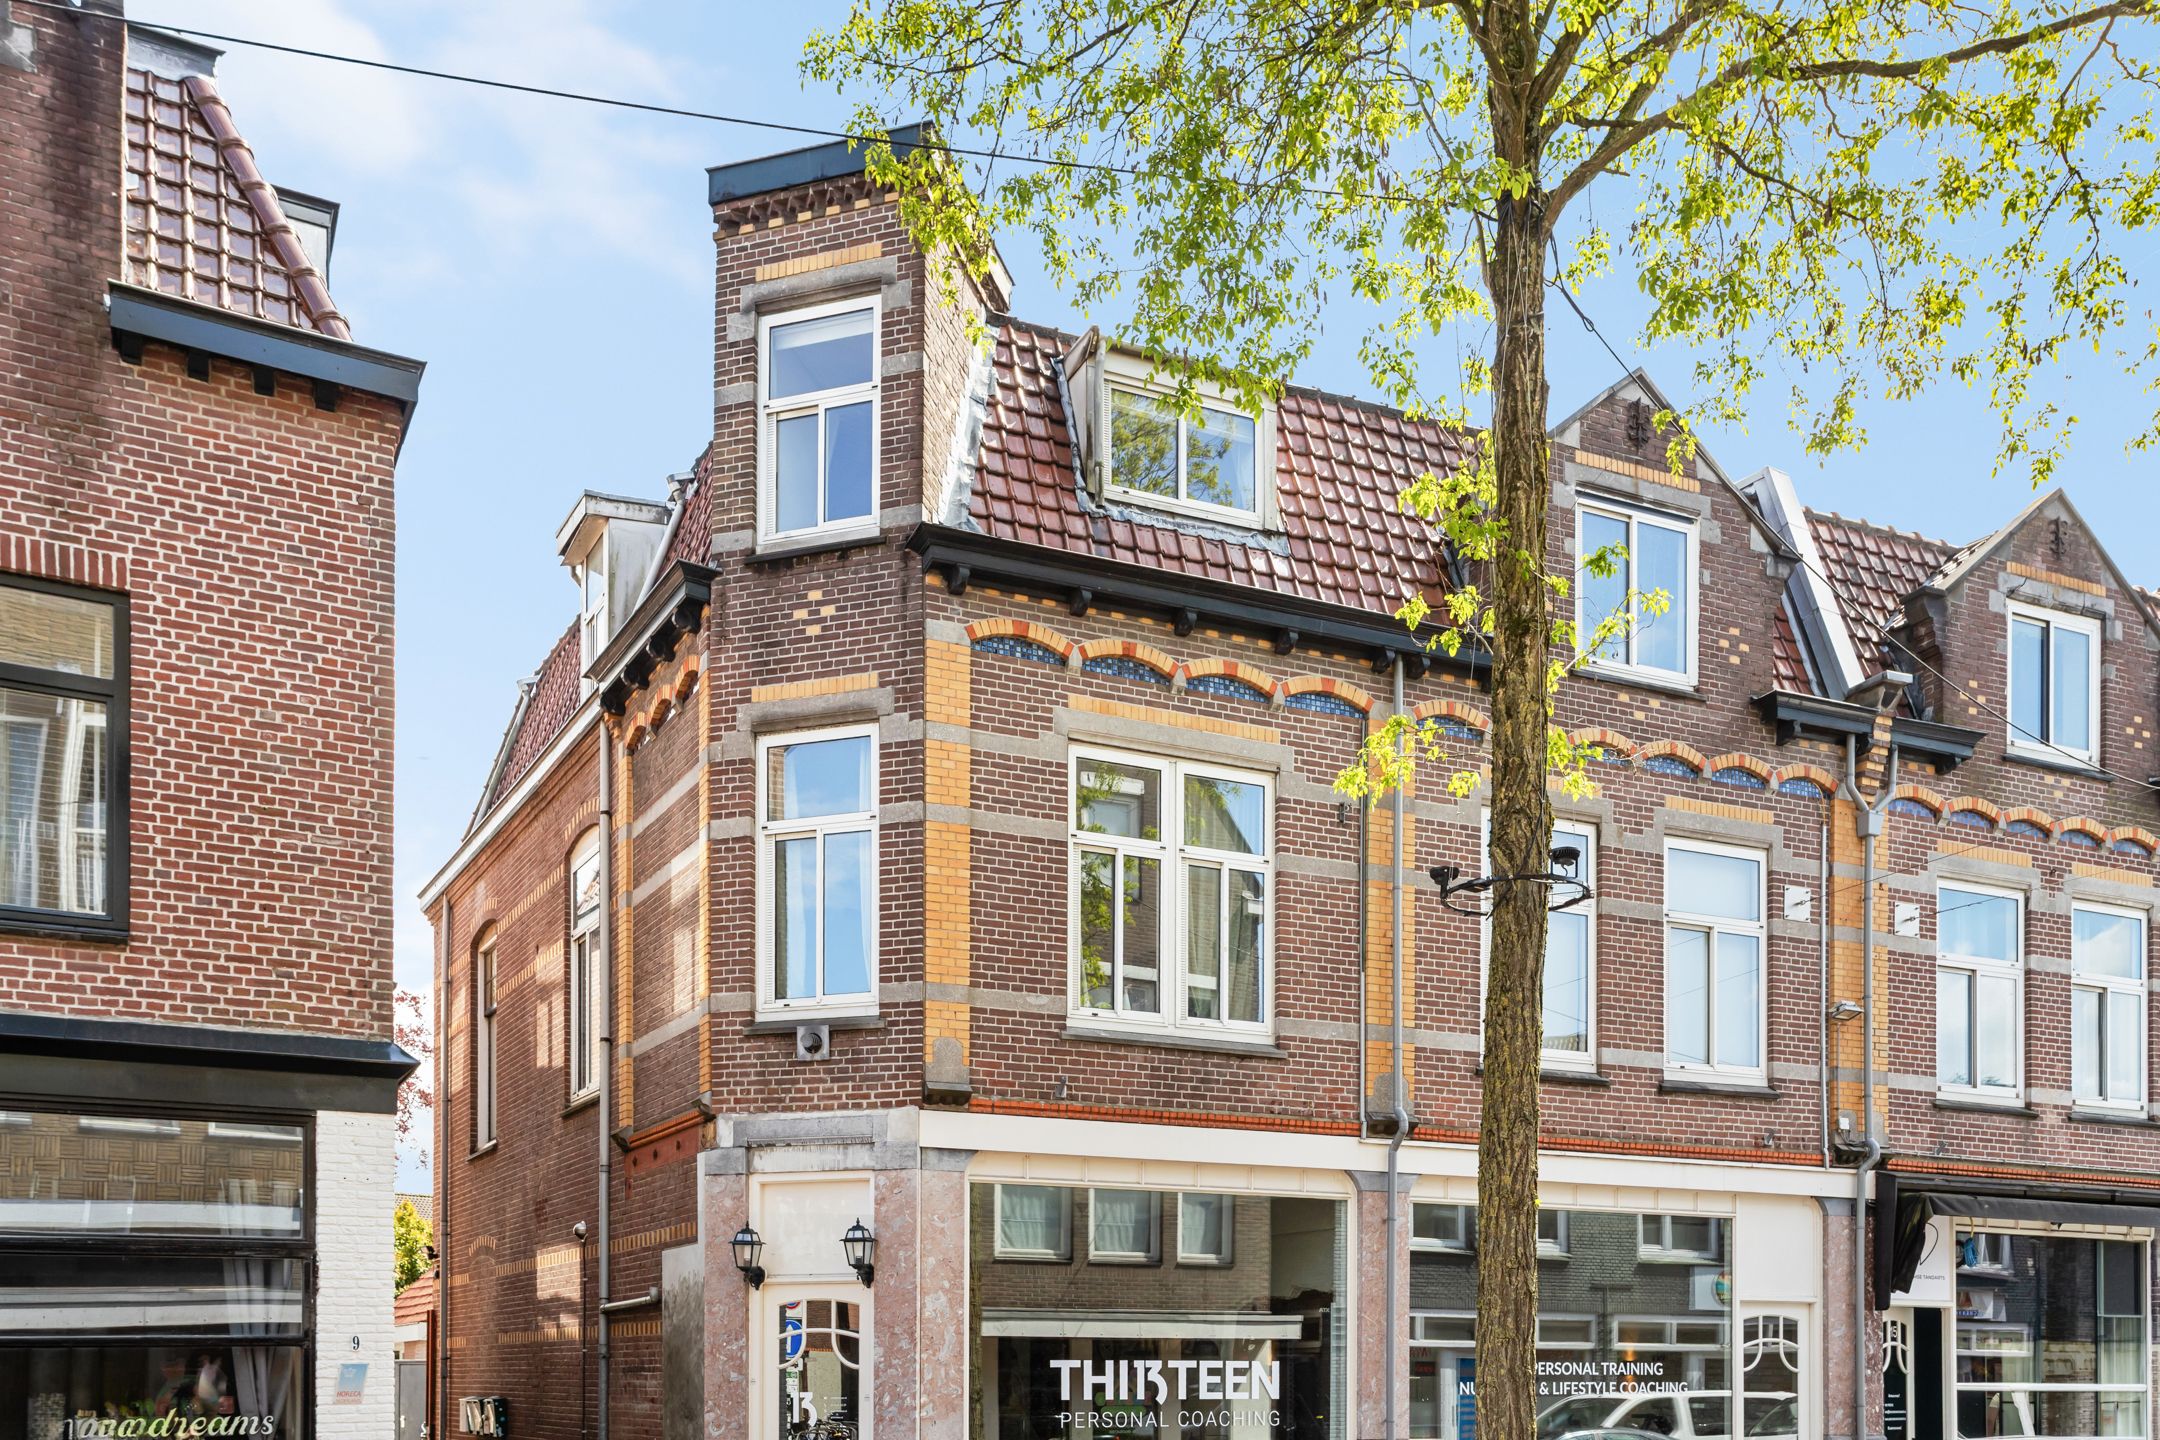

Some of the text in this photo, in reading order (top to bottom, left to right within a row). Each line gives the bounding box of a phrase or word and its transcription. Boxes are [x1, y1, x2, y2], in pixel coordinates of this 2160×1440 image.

[352, 1335, 360, 1351] 9
[1534, 1361, 1664, 1376] ERSONAL TRAINING
[1539, 1382, 1688, 1395] & LIFESTYLE COACHING
[790, 1391, 818, 1427] 13
[1060, 1410, 1281, 1429] PERSONAL COACHING
